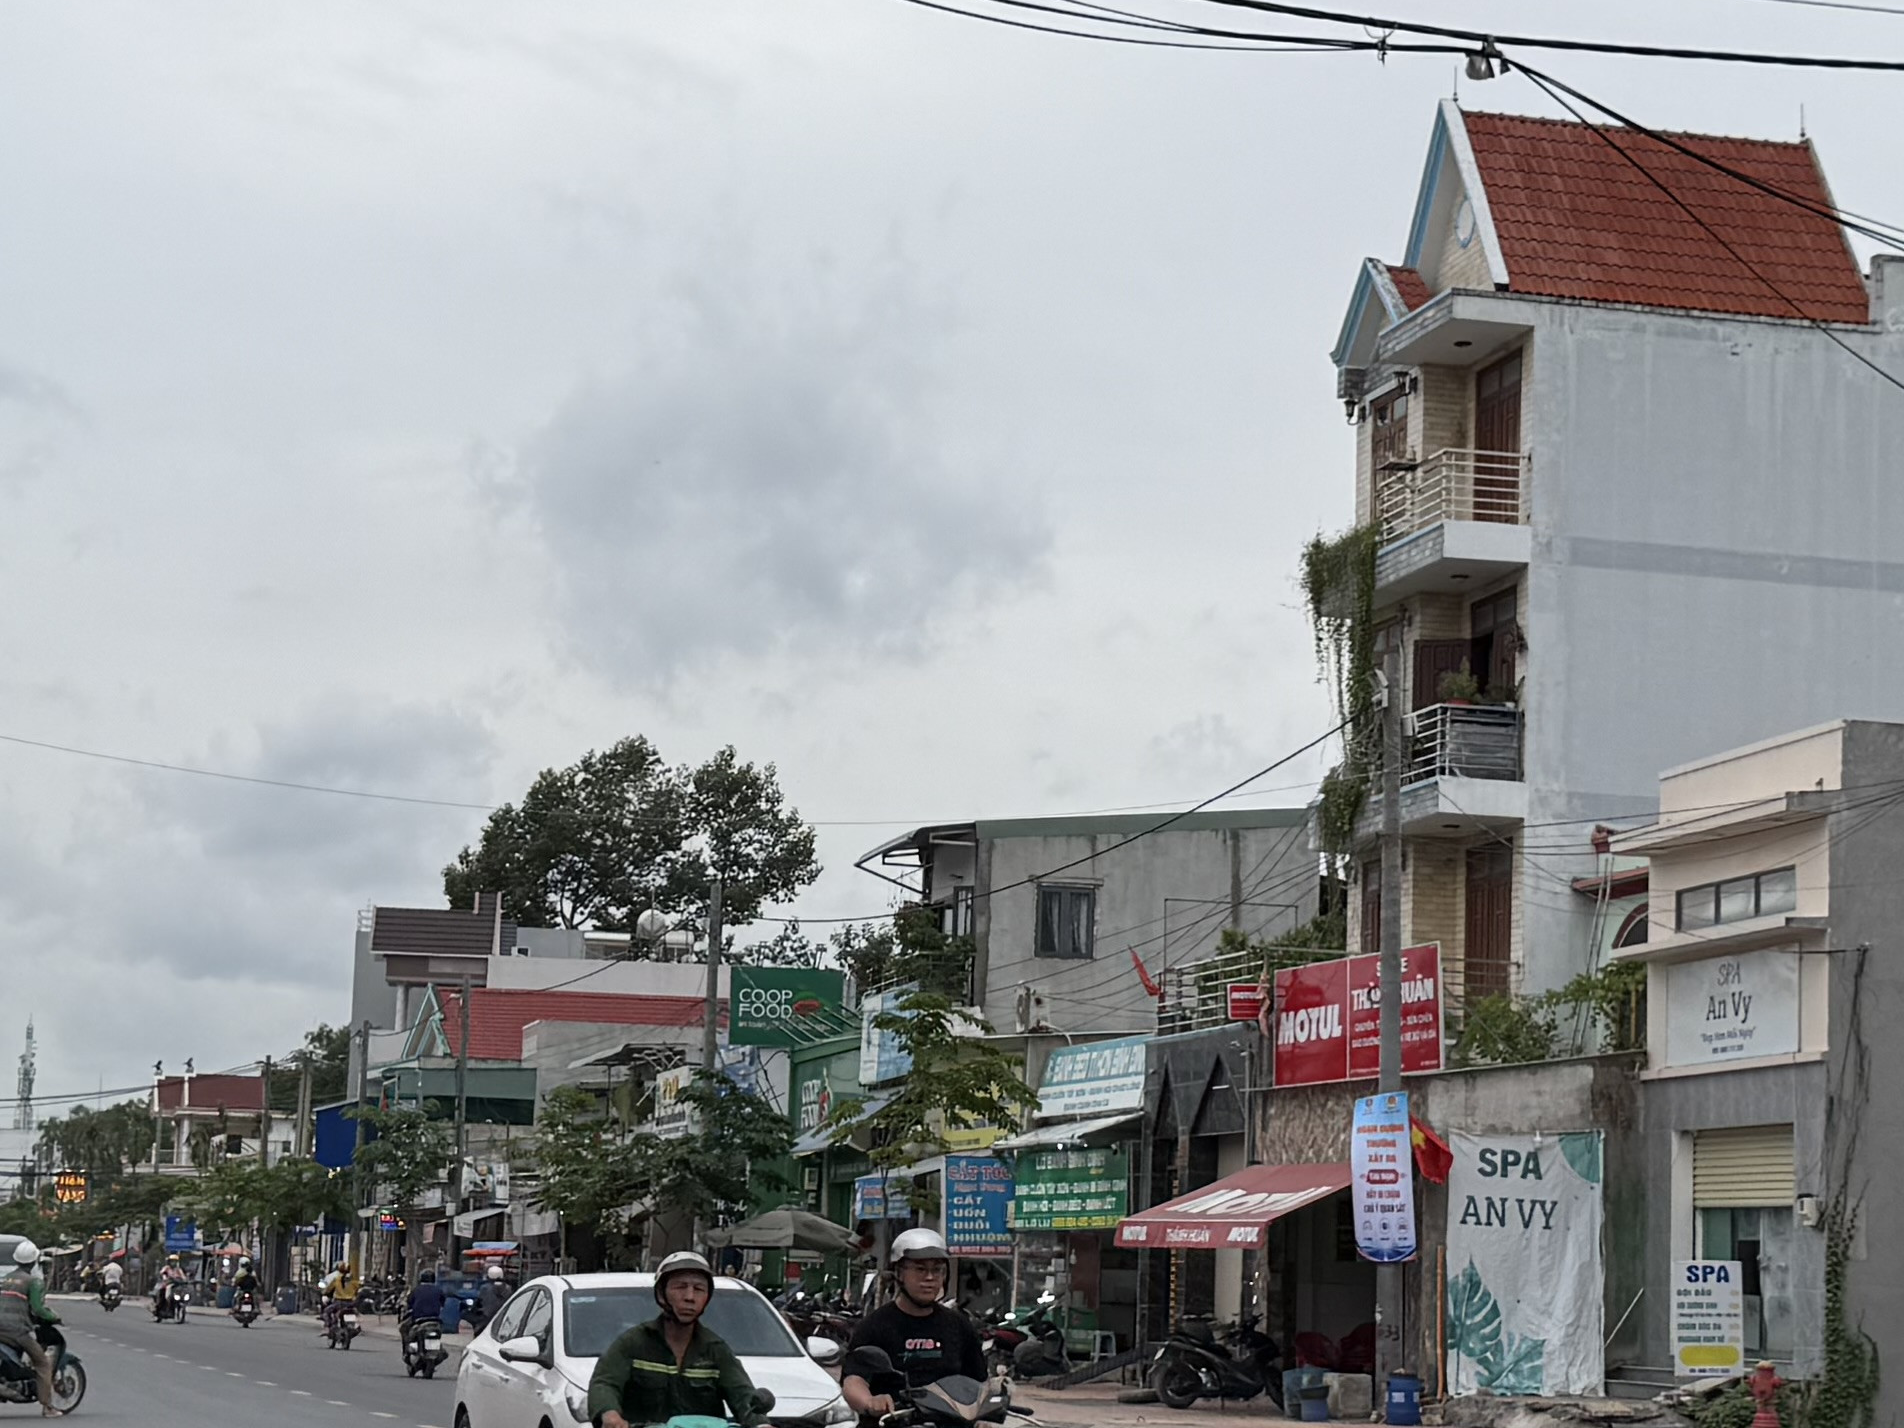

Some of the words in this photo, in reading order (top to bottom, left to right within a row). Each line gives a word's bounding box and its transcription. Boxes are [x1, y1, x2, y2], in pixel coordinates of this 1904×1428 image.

[1717, 962, 1742, 987] SPA
[739, 1003, 793, 1019] FOOD
[1705, 994, 1728, 1022] An
[1730, 990, 1753, 1025] Vy
[1277, 1004, 1342, 1046] MOTUL
[1477, 1147, 1543, 1181] SPA
[1459, 1195, 1509, 1228] AN
[1516, 1198, 1558, 1231] VY
[1227, 1226, 1260, 1242] MOTUL
[1686, 1264, 1730, 1283] SPA
